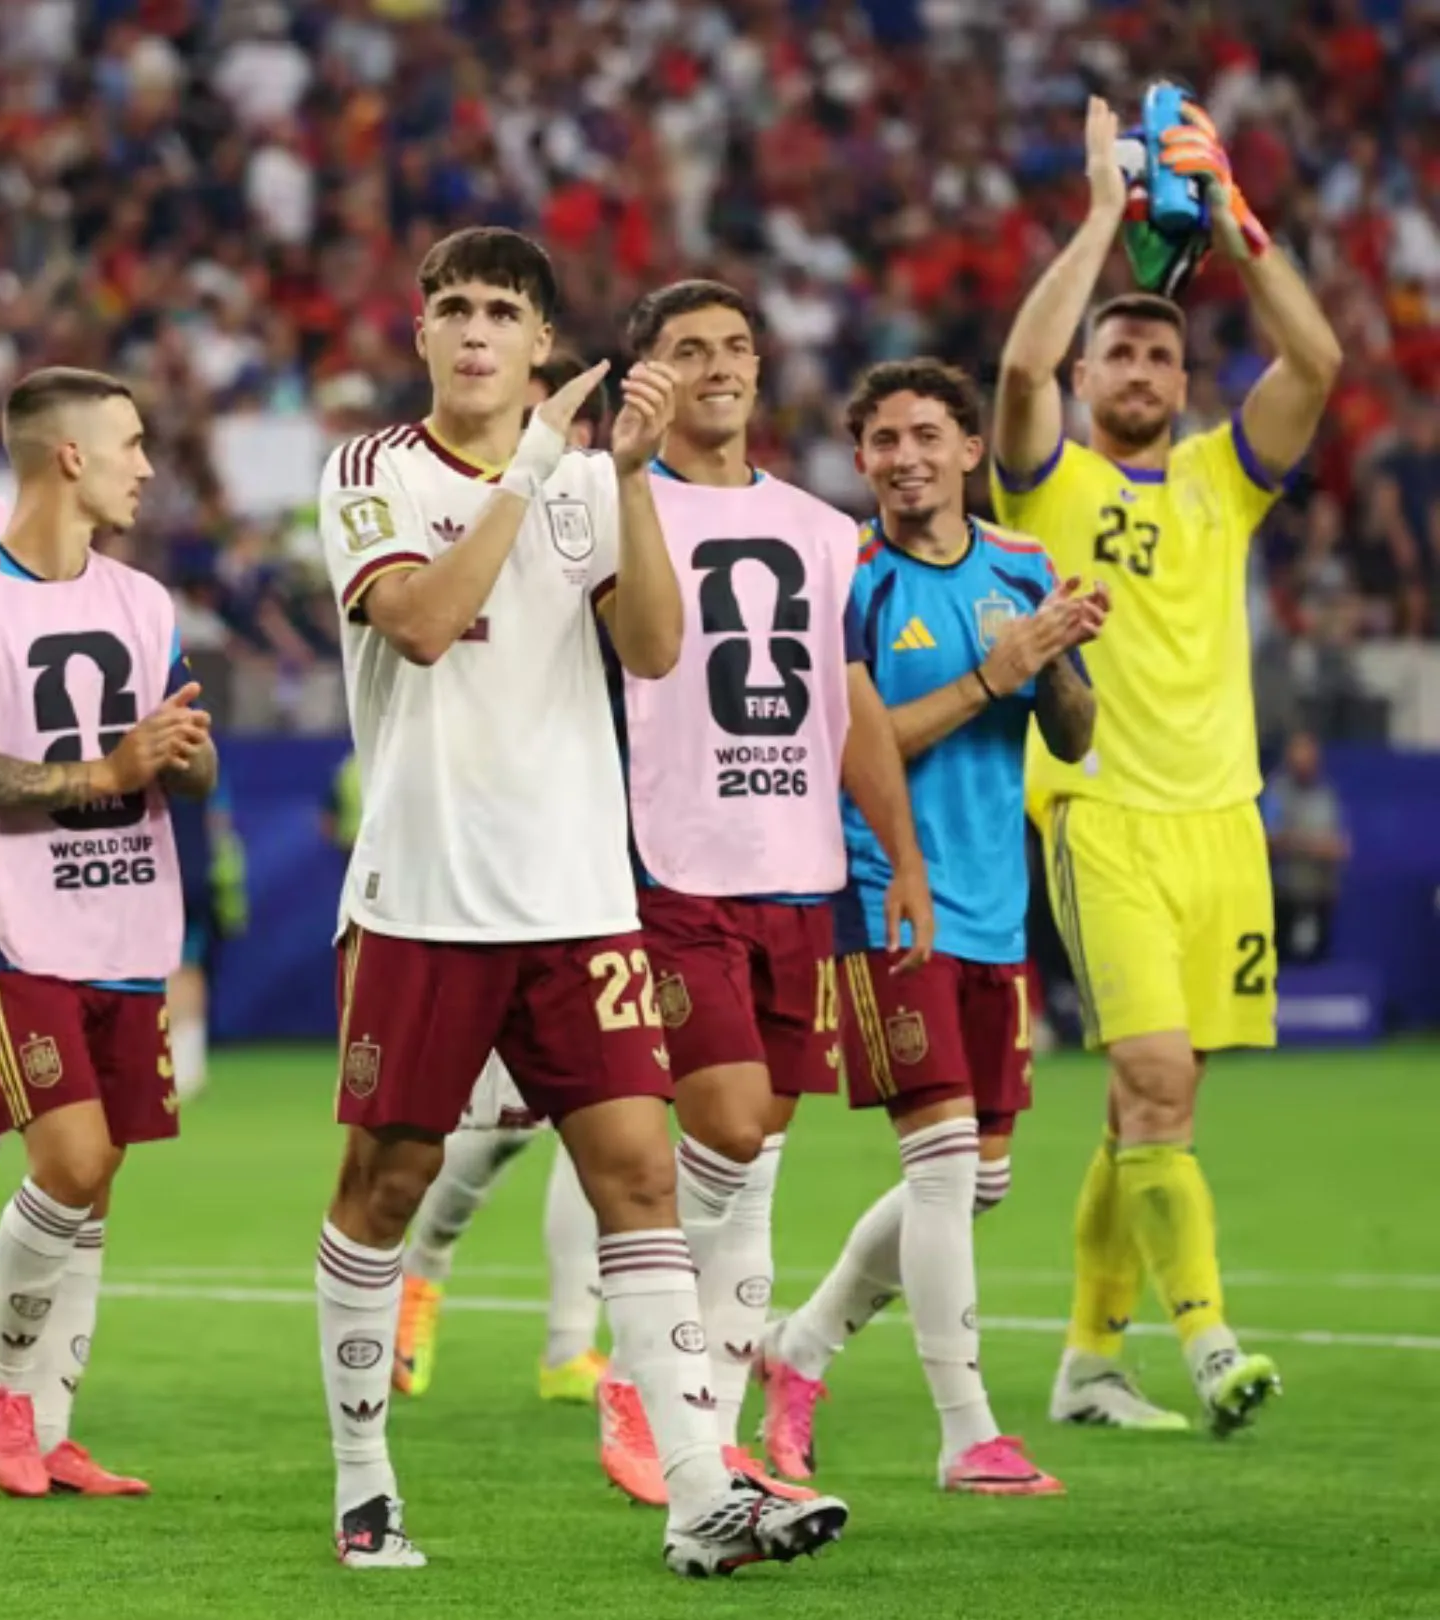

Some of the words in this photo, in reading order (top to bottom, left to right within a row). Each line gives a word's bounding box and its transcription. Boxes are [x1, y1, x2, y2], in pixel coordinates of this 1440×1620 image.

[1093, 505, 1161, 578] 23
[744, 695, 792, 719] FIFA
[717, 768, 808, 798] 2026
[50, 838, 118, 859] WORLD
[53, 857, 156, 890] 2026
[1234, 931, 1277, 995] 2
[588, 948, 663, 1031] 22
